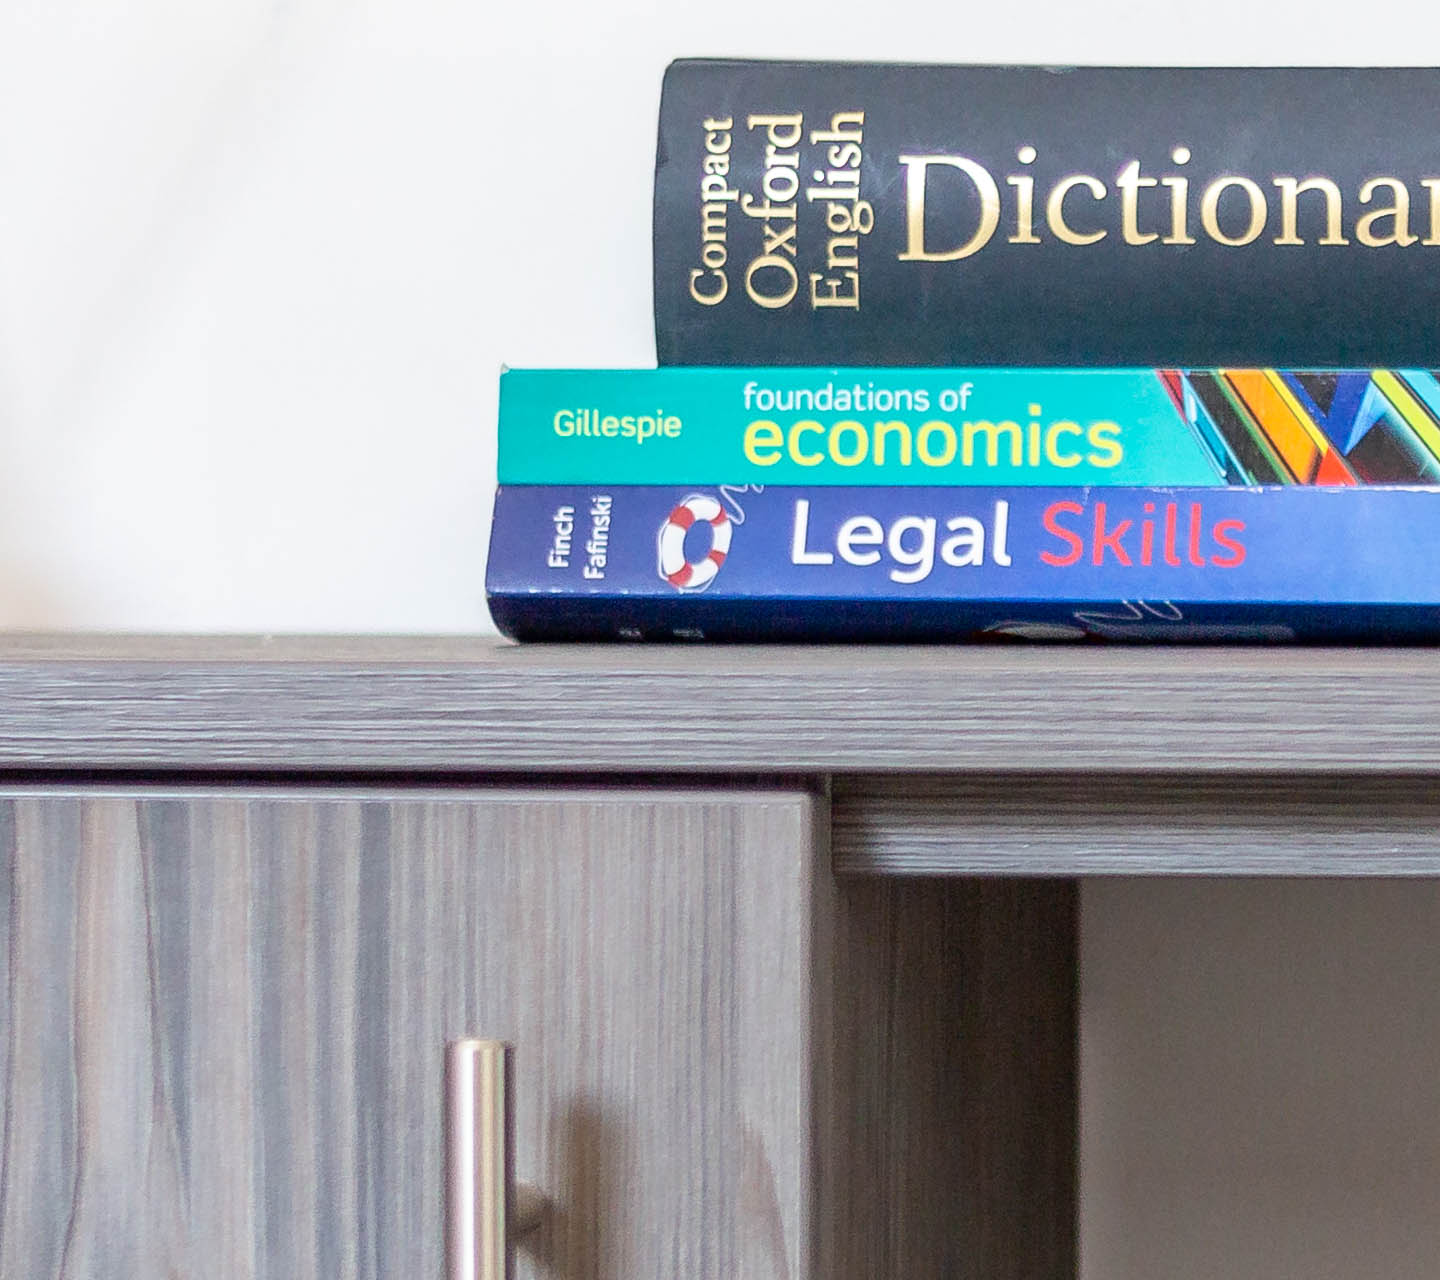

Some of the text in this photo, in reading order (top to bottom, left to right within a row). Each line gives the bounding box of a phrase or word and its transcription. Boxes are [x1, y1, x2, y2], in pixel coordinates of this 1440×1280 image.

[691, 118, 738, 304] Compact
[742, 114, 802, 308] Oxford
[807, 112, 873, 310] English
[554, 409, 682, 444] Gillespie
[744, 382, 973, 411] foundations of
[744, 406, 1123, 467] economics
[548, 507, 574, 567] Finch
[583, 496, 611, 578] Fafinski
[792, 500, 1246, 583] Legal Skills
